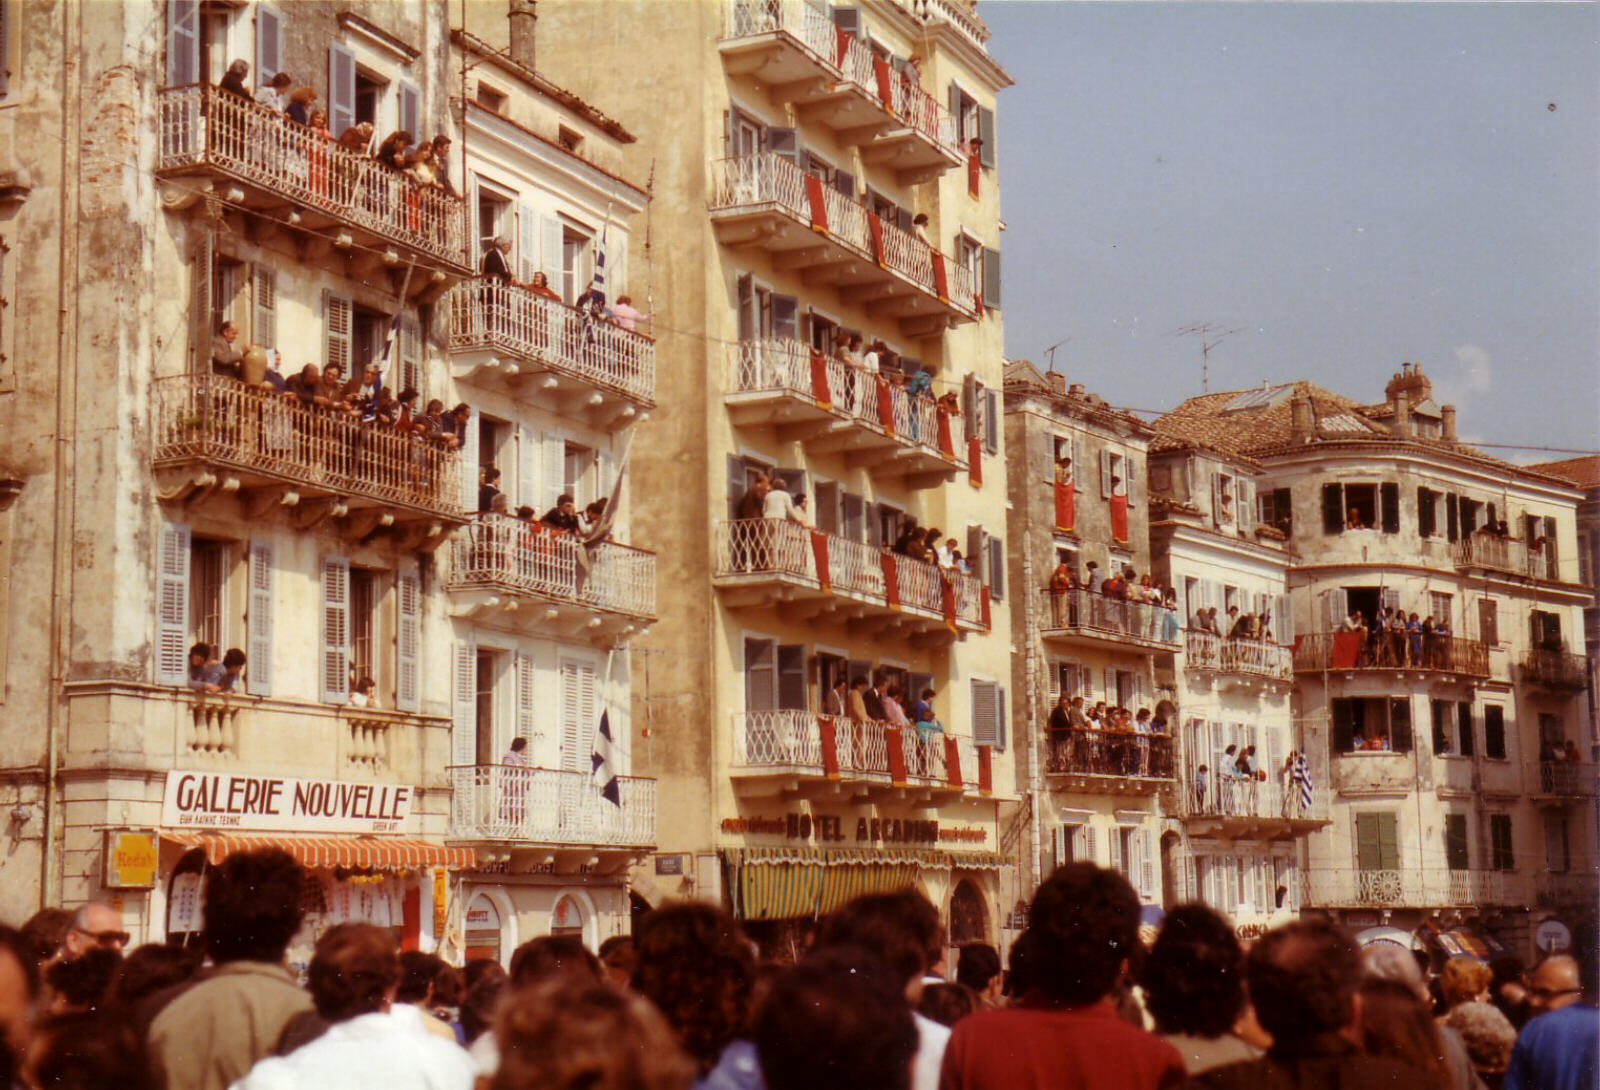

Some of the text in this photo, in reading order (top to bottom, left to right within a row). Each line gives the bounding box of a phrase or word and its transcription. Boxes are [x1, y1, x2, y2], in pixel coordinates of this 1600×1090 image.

[176, 774, 409, 820] GALERIE NOUVELLE
[786, 813, 846, 842] HOTEL
